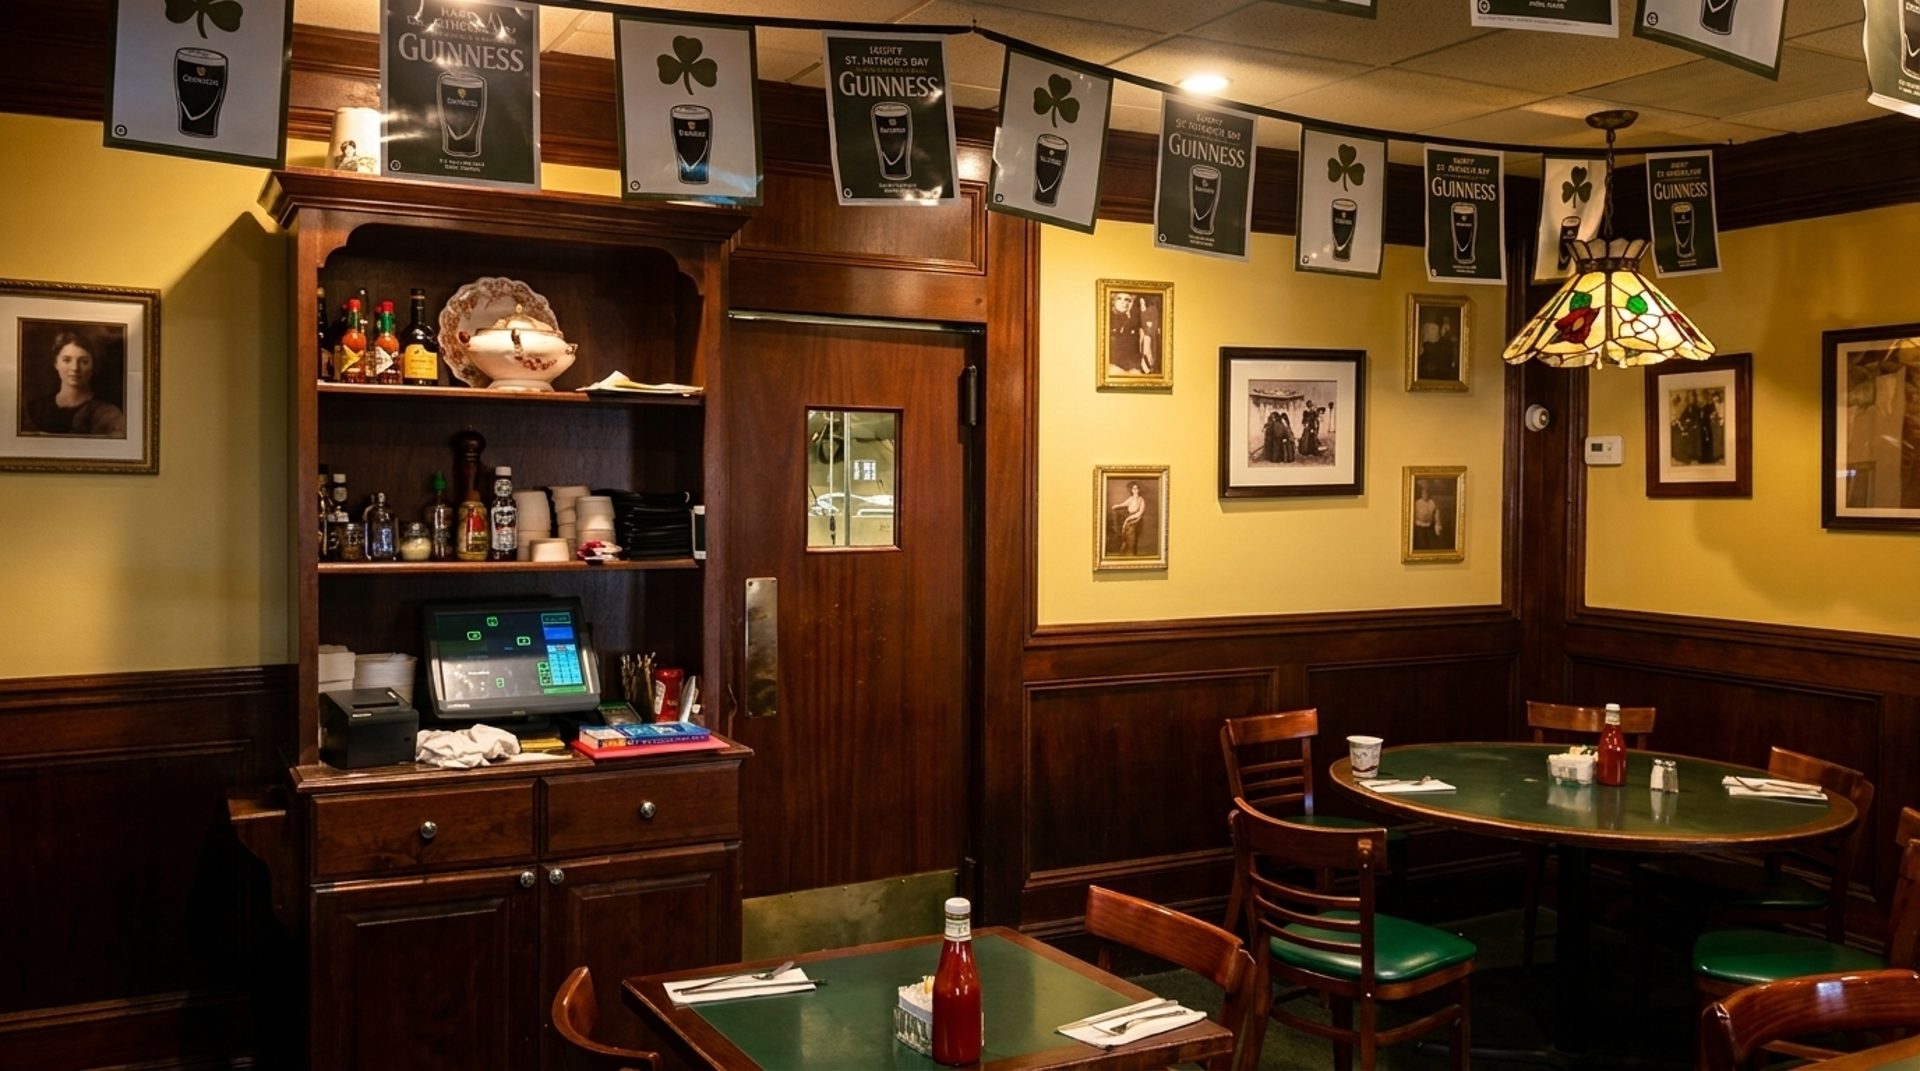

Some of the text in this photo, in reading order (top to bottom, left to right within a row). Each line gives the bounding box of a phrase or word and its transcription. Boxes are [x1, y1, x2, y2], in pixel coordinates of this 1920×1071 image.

[398, 32, 524, 72] GUINNESS
[839, 70, 941, 98] GUINNESS
[1168, 132, 1246, 169] GUINNESS
[1431, 176, 1497, 202] GUINNESS
[1653, 181, 1709, 201] GUINNESS
